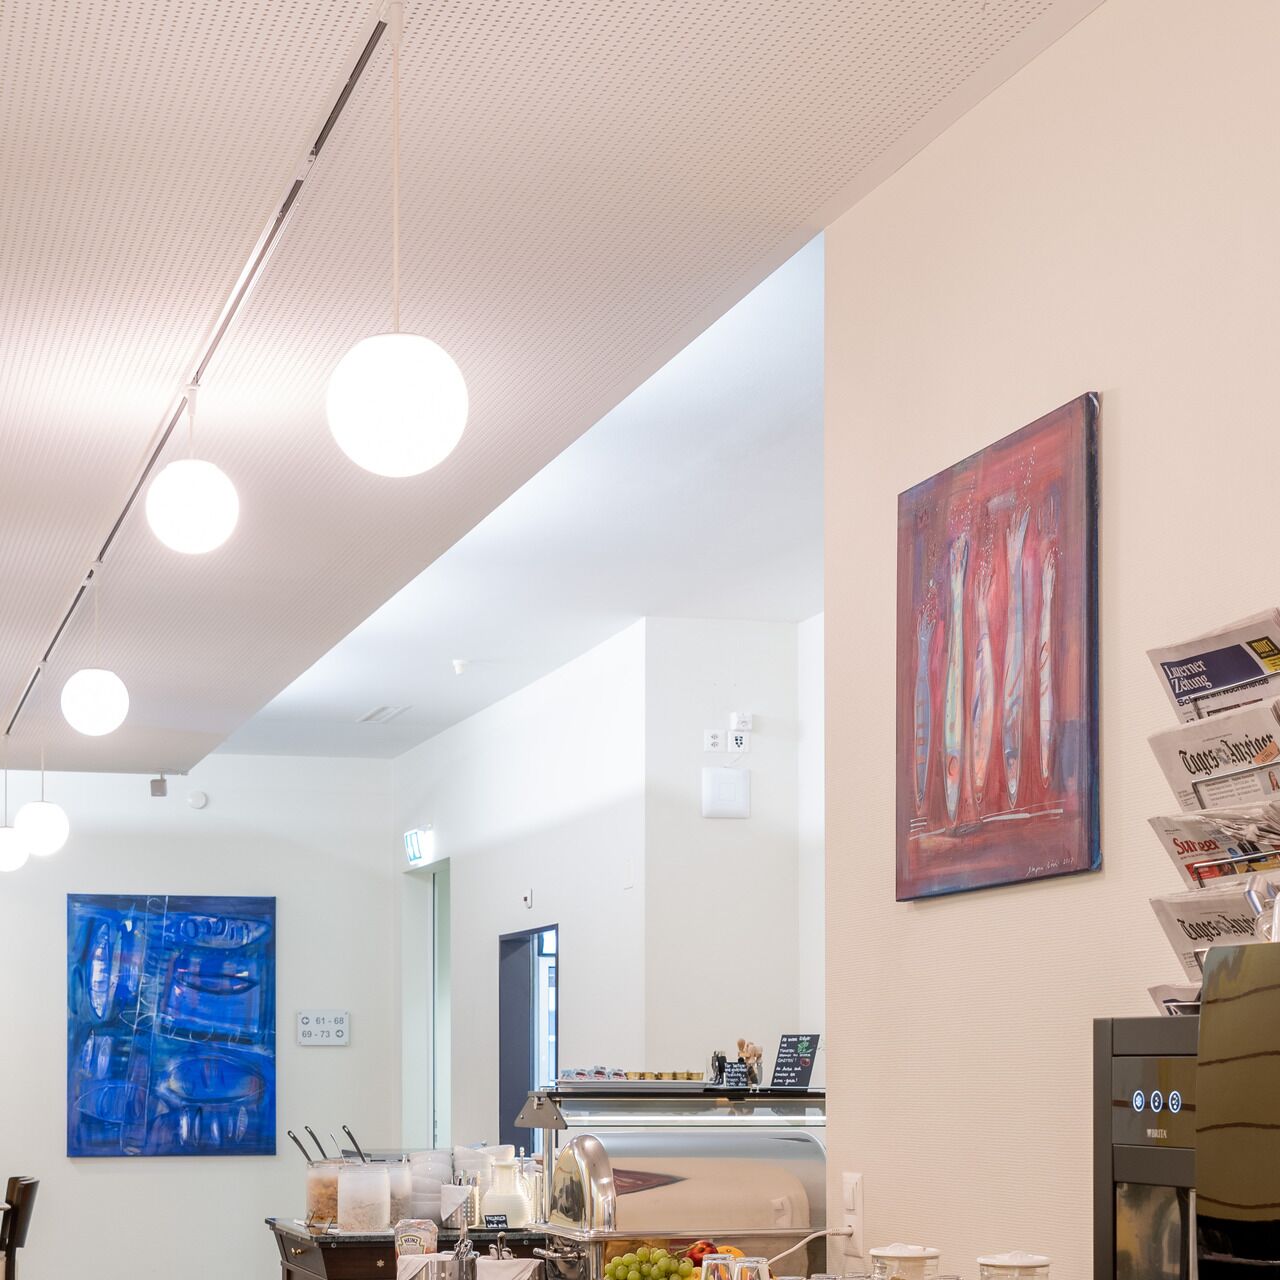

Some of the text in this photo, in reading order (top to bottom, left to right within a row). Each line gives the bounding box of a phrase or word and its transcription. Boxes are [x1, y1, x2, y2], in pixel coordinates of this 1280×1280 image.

[1164, 660, 1207, 679] Luzerner
[1171, 674, 1213, 693] Zeitung
[315, 1016, 325, 1024] 61
[334, 1016, 344, 1025] 68
[302, 1030, 312, 1038] 69
[320, 1030, 330, 1038] 73
